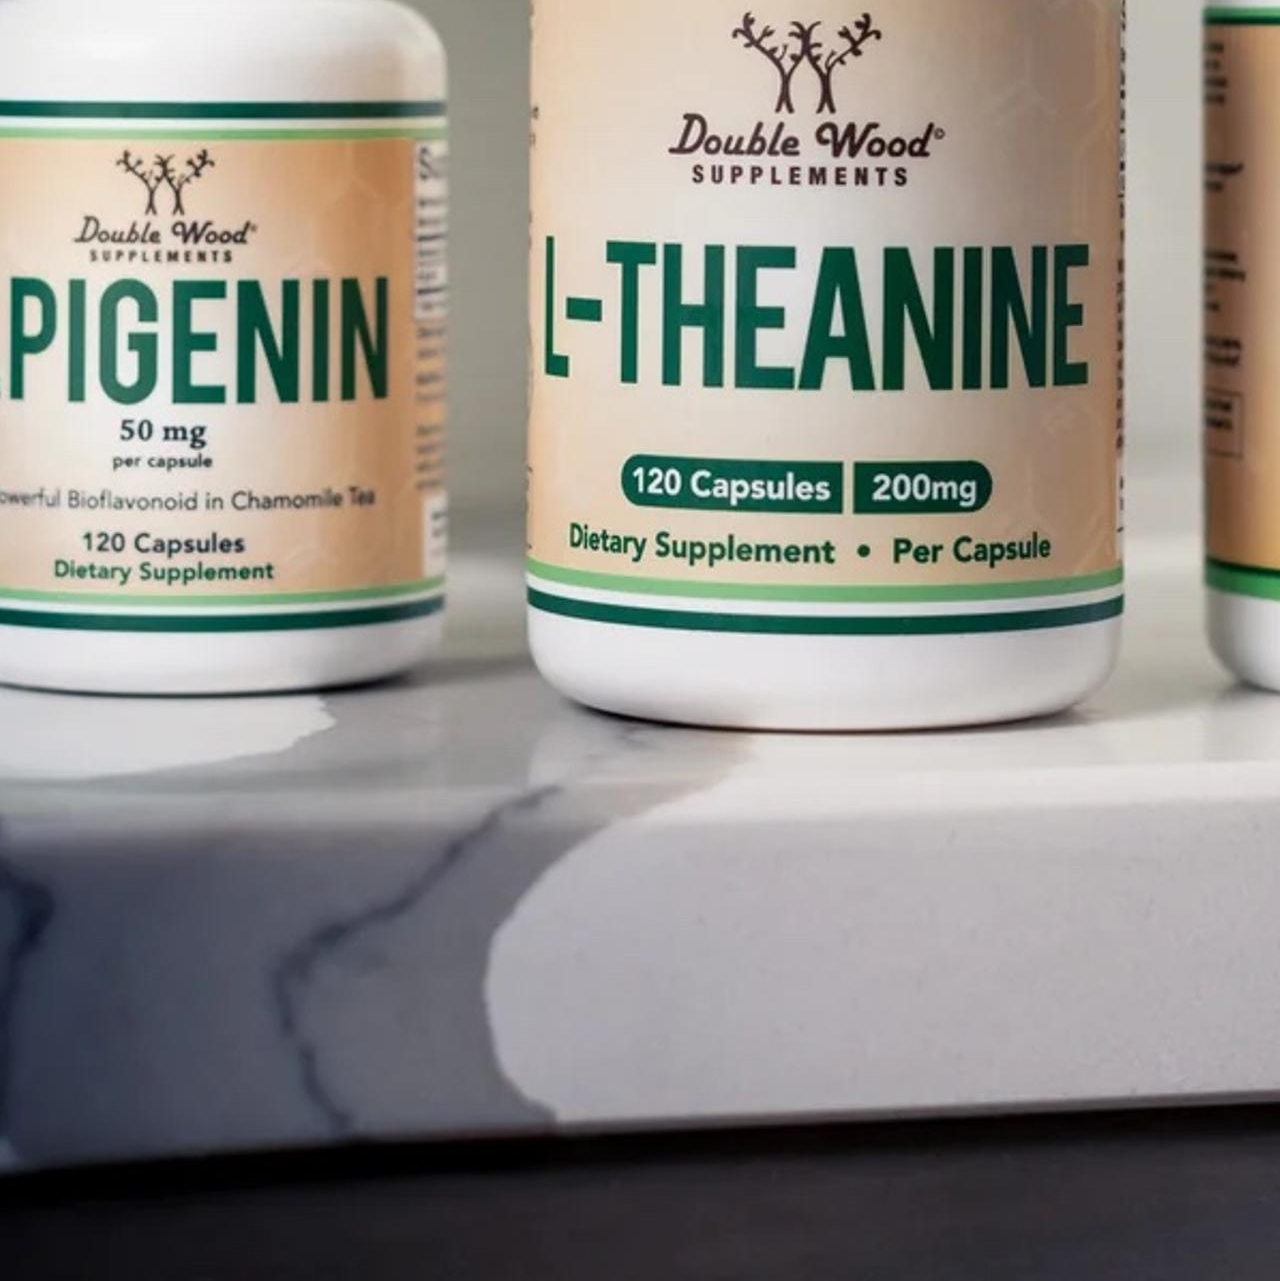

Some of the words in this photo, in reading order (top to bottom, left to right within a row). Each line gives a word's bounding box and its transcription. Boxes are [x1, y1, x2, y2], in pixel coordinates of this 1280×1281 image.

[668, 113, 800, 157] Double
[692, 165, 908, 186] SUPPLEMENTS
[74, 216, 161, 244] Double
[89, 249, 233, 263] SUPPLEMENTS
[545, 235, 1089, 391] L-THEANINE
[120, 419, 152, 441] 50
[162, 422, 206, 449] mg
[113, 455, 141, 471] per
[147, 453, 213, 471] capsule
[68, 490, 198, 511] Bioflavonoid
[205, 491, 223, 510] in
[231, 487, 342, 510] Chamomile
[348, 485, 376, 507] Tea
[632, 467, 682, 496] 120
[690, 470, 831, 506] Capsules
[871, 473, 978, 506] 200mg
[82, 532, 125, 553] 120
[134, 532, 245, 559] Capsules
[569, 522, 647, 562] Dietary
[655, 530, 836, 568] Supplement
[893, 537, 944, 564] Per
[952, 532, 1051, 568] Capsule
[54, 559, 132, 586] Dietary
[139, 561, 275, 586] Supplement
